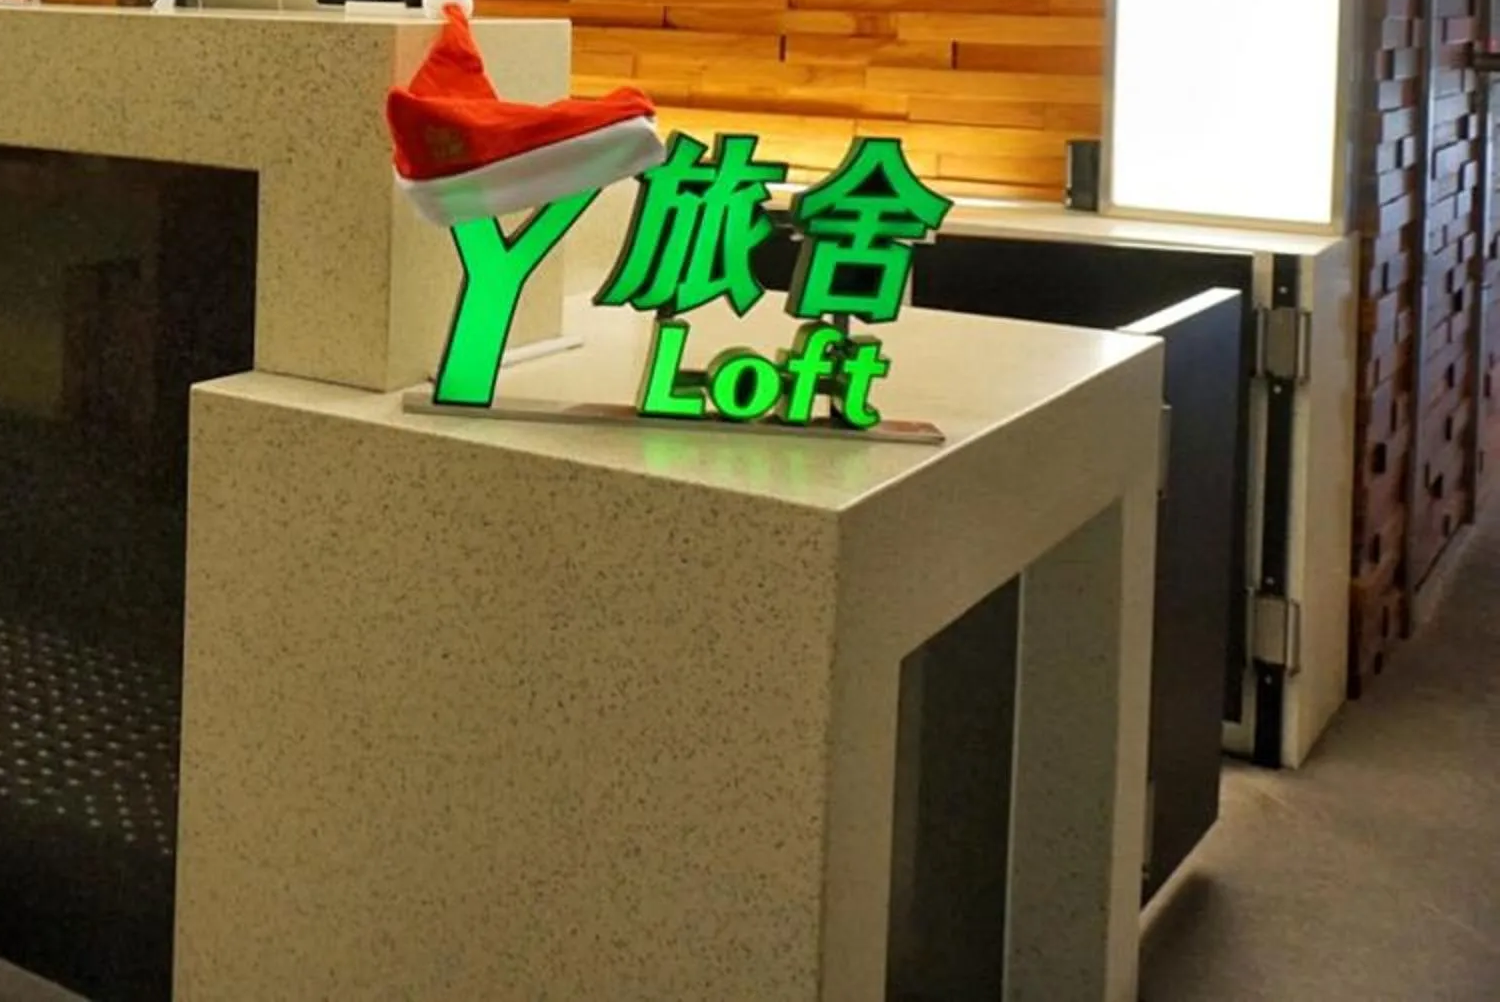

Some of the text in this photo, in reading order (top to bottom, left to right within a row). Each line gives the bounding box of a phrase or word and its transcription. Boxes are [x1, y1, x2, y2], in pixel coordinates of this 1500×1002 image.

[433, 132, 953, 408] Y 旅舍
[638, 320, 888, 429] Loft
